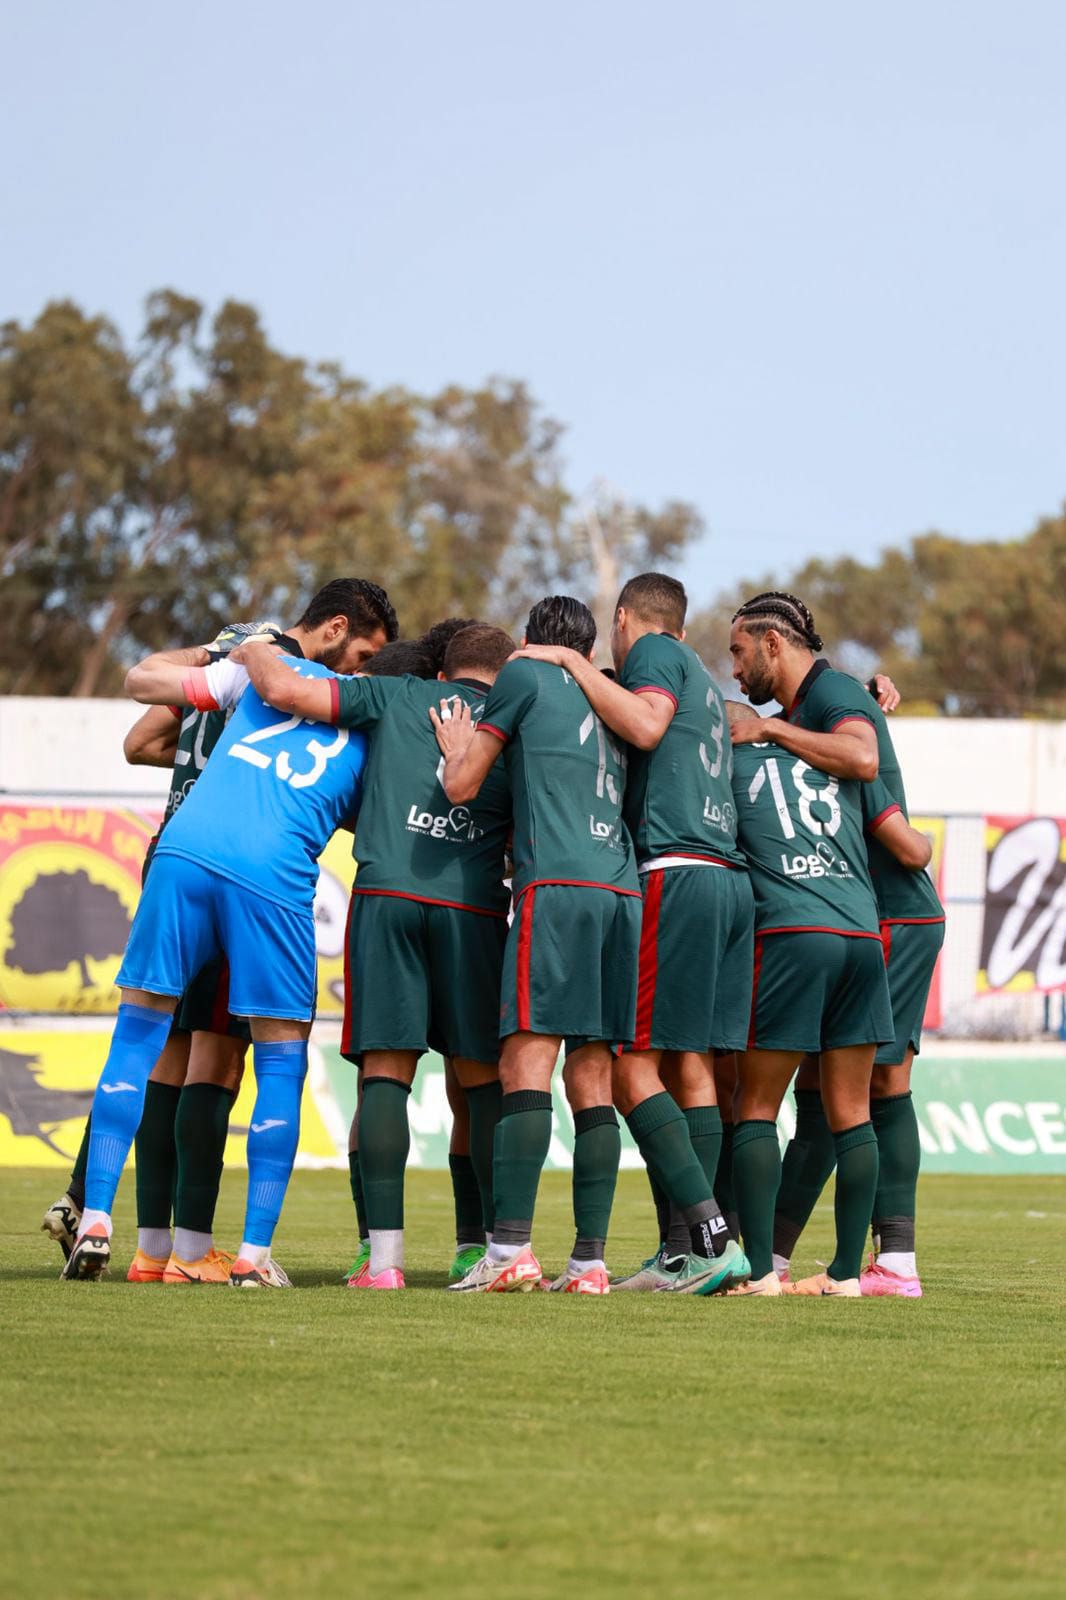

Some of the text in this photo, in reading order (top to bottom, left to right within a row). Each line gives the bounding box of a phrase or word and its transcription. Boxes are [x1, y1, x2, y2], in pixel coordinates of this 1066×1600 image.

[227, 701, 349, 789] 23
[699, 687, 734, 783] 3
[748, 757, 842, 840] 18
[919, 1101, 1066, 1155] NCE
